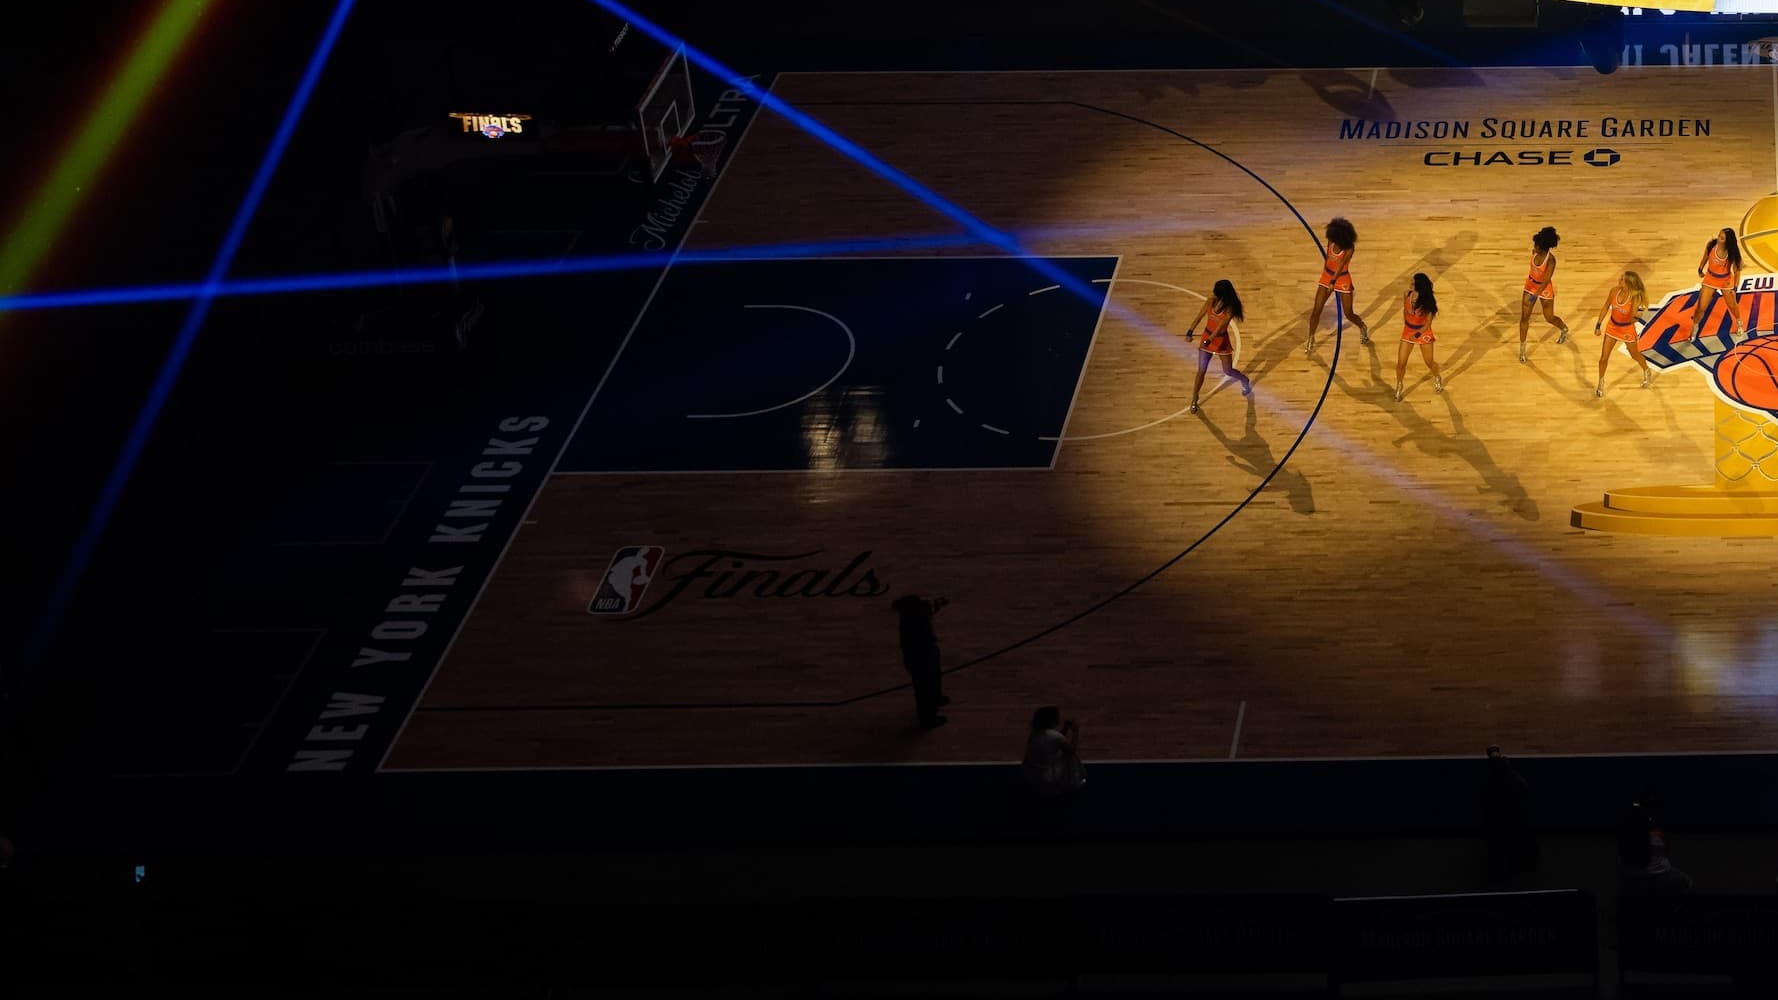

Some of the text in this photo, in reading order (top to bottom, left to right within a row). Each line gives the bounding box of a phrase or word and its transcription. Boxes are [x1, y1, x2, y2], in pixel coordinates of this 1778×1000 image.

[462, 115, 522, 134] FINALS
[1338, 116, 1712, 141] MADISON SQUARE GARDEN
[1423, 150, 1574, 167] CHASE
[1738, 277, 1774, 291] EW
[283, 415, 552, 775] NEW YORK KNICKS
[608, 549, 891, 623] Finals
